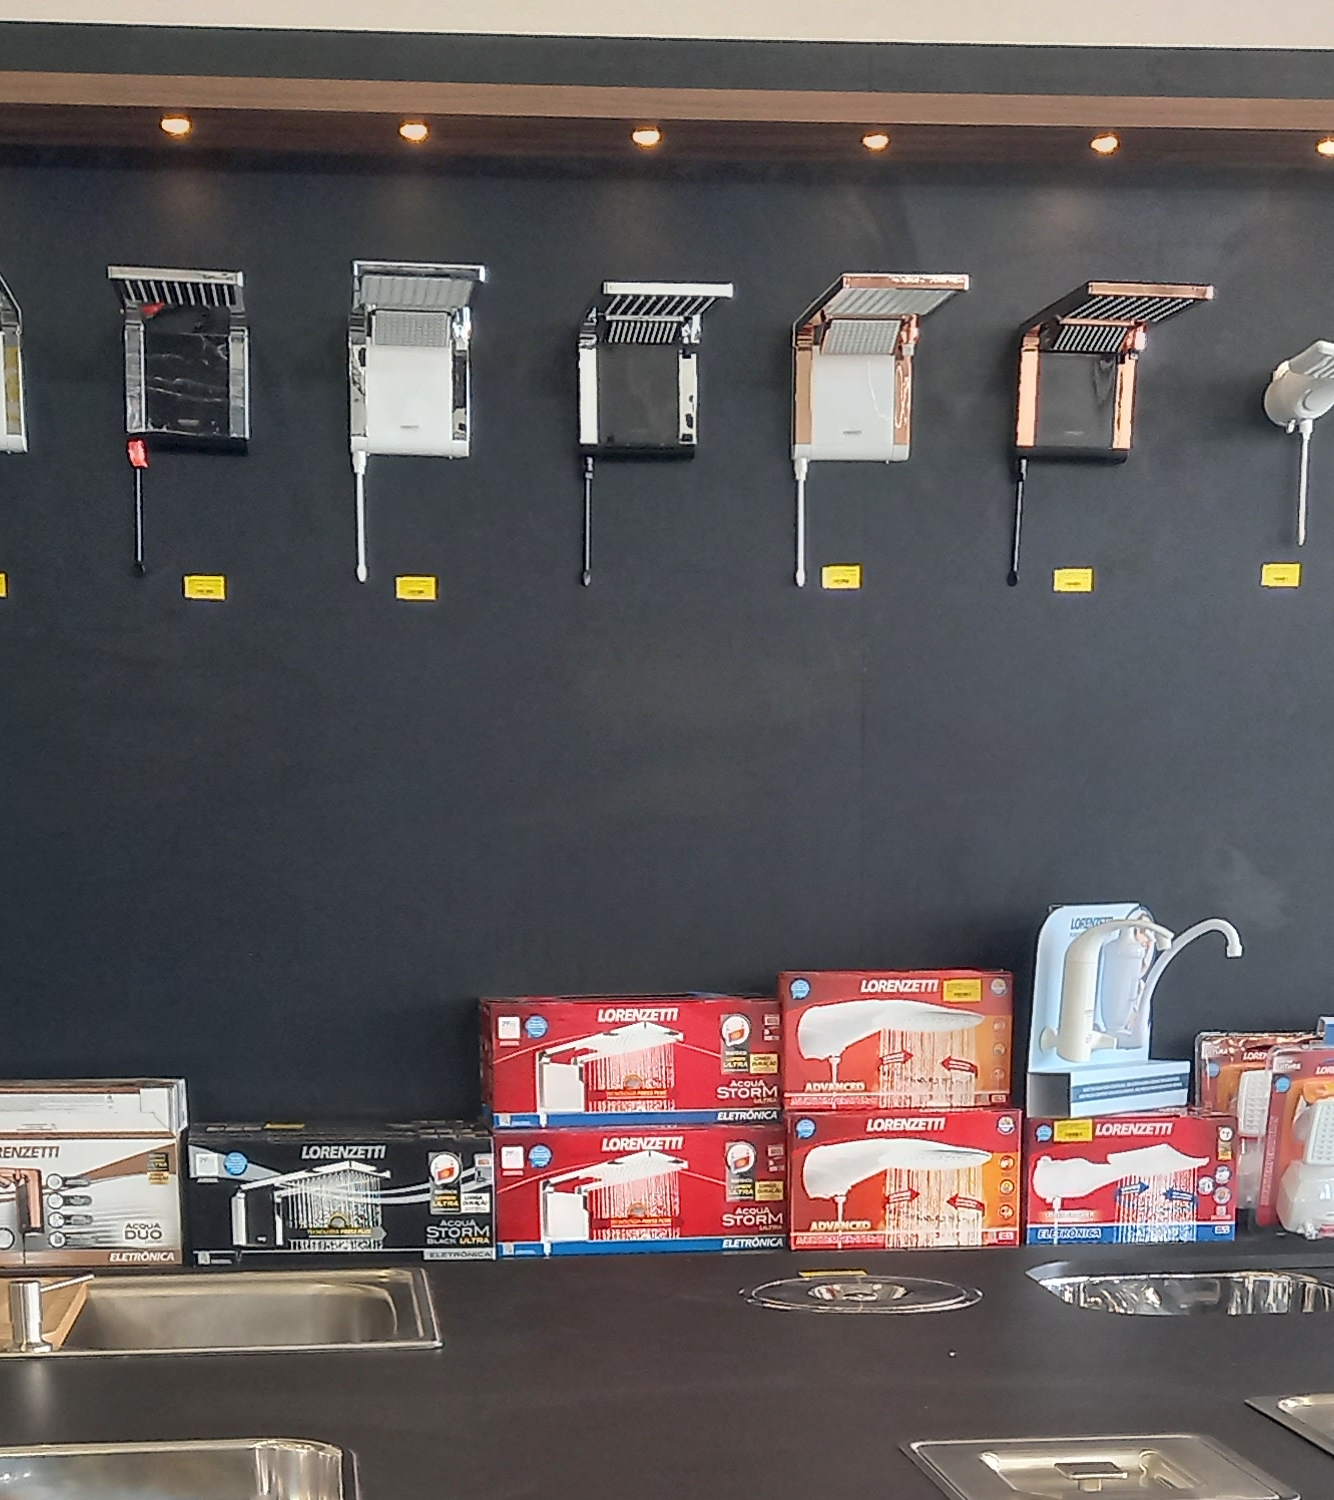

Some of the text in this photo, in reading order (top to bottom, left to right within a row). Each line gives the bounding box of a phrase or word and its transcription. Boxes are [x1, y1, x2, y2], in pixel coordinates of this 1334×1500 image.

[1070, 916, 1114, 930] LORENZ
[861, 979, 939, 993] LORENZETTI
[597, 1007, 679, 1023] LORENZETTI
[729, 1079, 765, 1087] ACQUA
[805, 1081, 866, 1093] ADVANCED
[716, 1085, 778, 1099] STORM
[717, 1109, 778, 1121] ELETRÔNICA
[866, 1117, 946, 1132] LORENZETTI
[1094, 1122, 1173, 1136] LORENZETTI
[601, 1135, 684, 1151] LORENZETTI
[301, 1145, 386, 1160] LORENZETTI
[735, 1206, 769, 1215] ACQUA
[125, 1222, 161, 1230] ACQUA
[440, 1219, 477, 1227] ACQUA
[722, 1213, 784, 1227] STORM
[810, 1220, 871, 1232] ADVANCED
[124, 1229, 163, 1240] DUO
[426, 1225, 490, 1239] STORM
[459, 1237, 490, 1245] ULTRA
[722, 1236, 784, 1249] ELETRÔNICA
[109, 1249, 176, 1263] ELETRÔNICA
[429, 1249, 492, 1258] ELETRÔNICA
